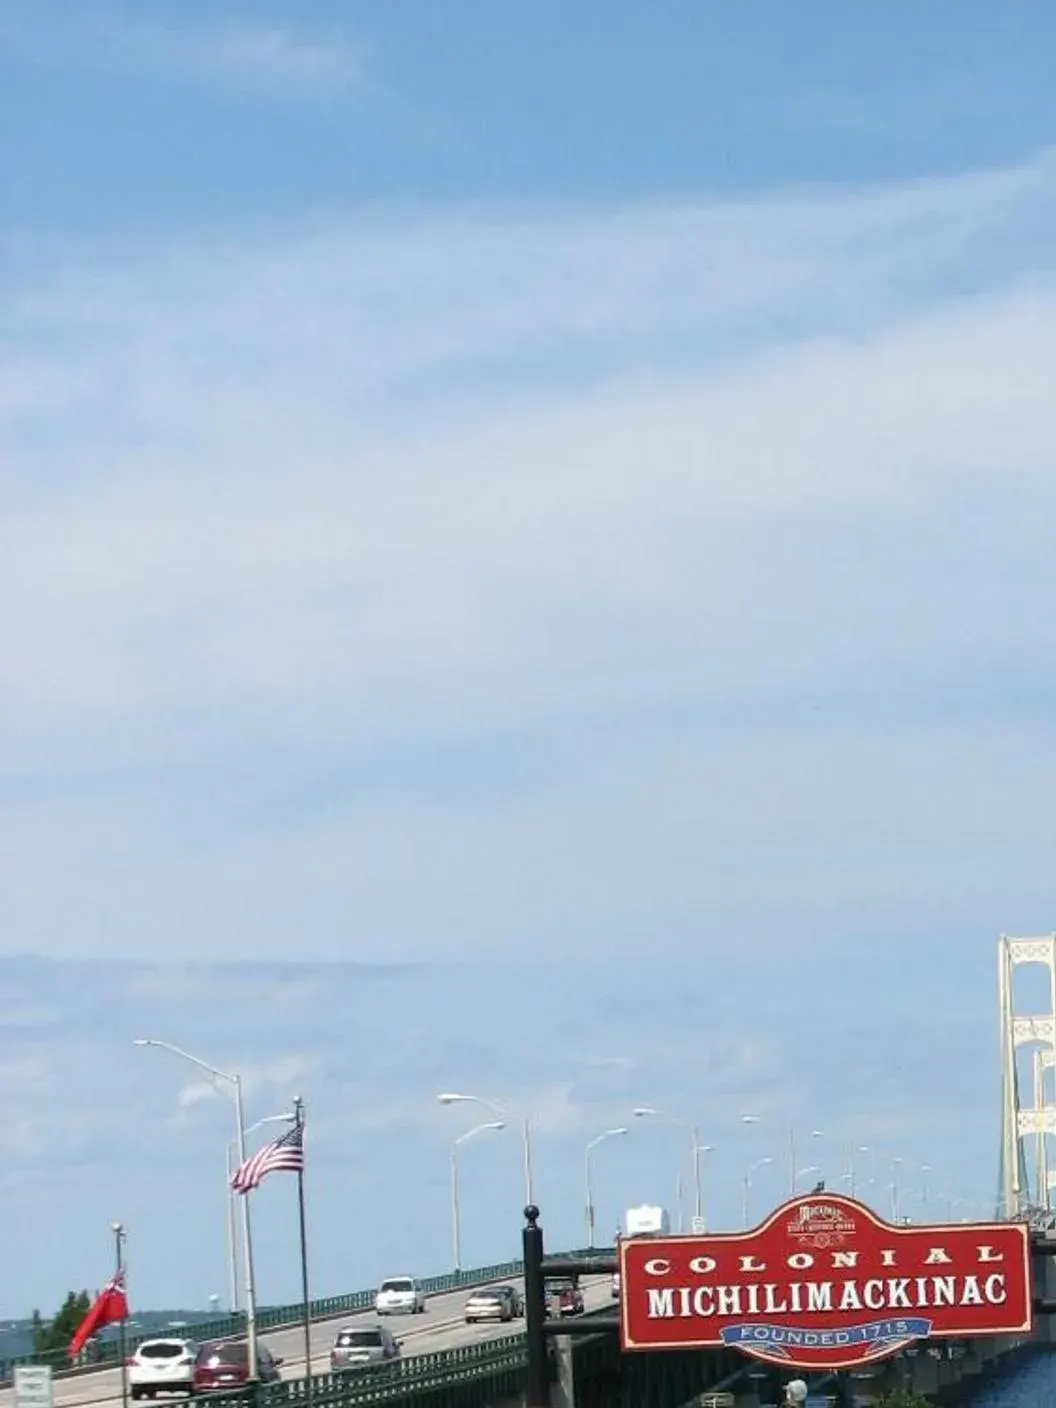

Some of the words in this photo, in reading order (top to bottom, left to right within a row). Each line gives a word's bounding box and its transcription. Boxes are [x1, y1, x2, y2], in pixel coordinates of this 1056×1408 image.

[644, 1246, 1004, 1276] COLONIAL
[646, 1273, 1006, 1319] MICHILIMACKINAC
[741, 1326, 850, 1345] FOUNDED
[861, 1321, 908, 1339] 1715
